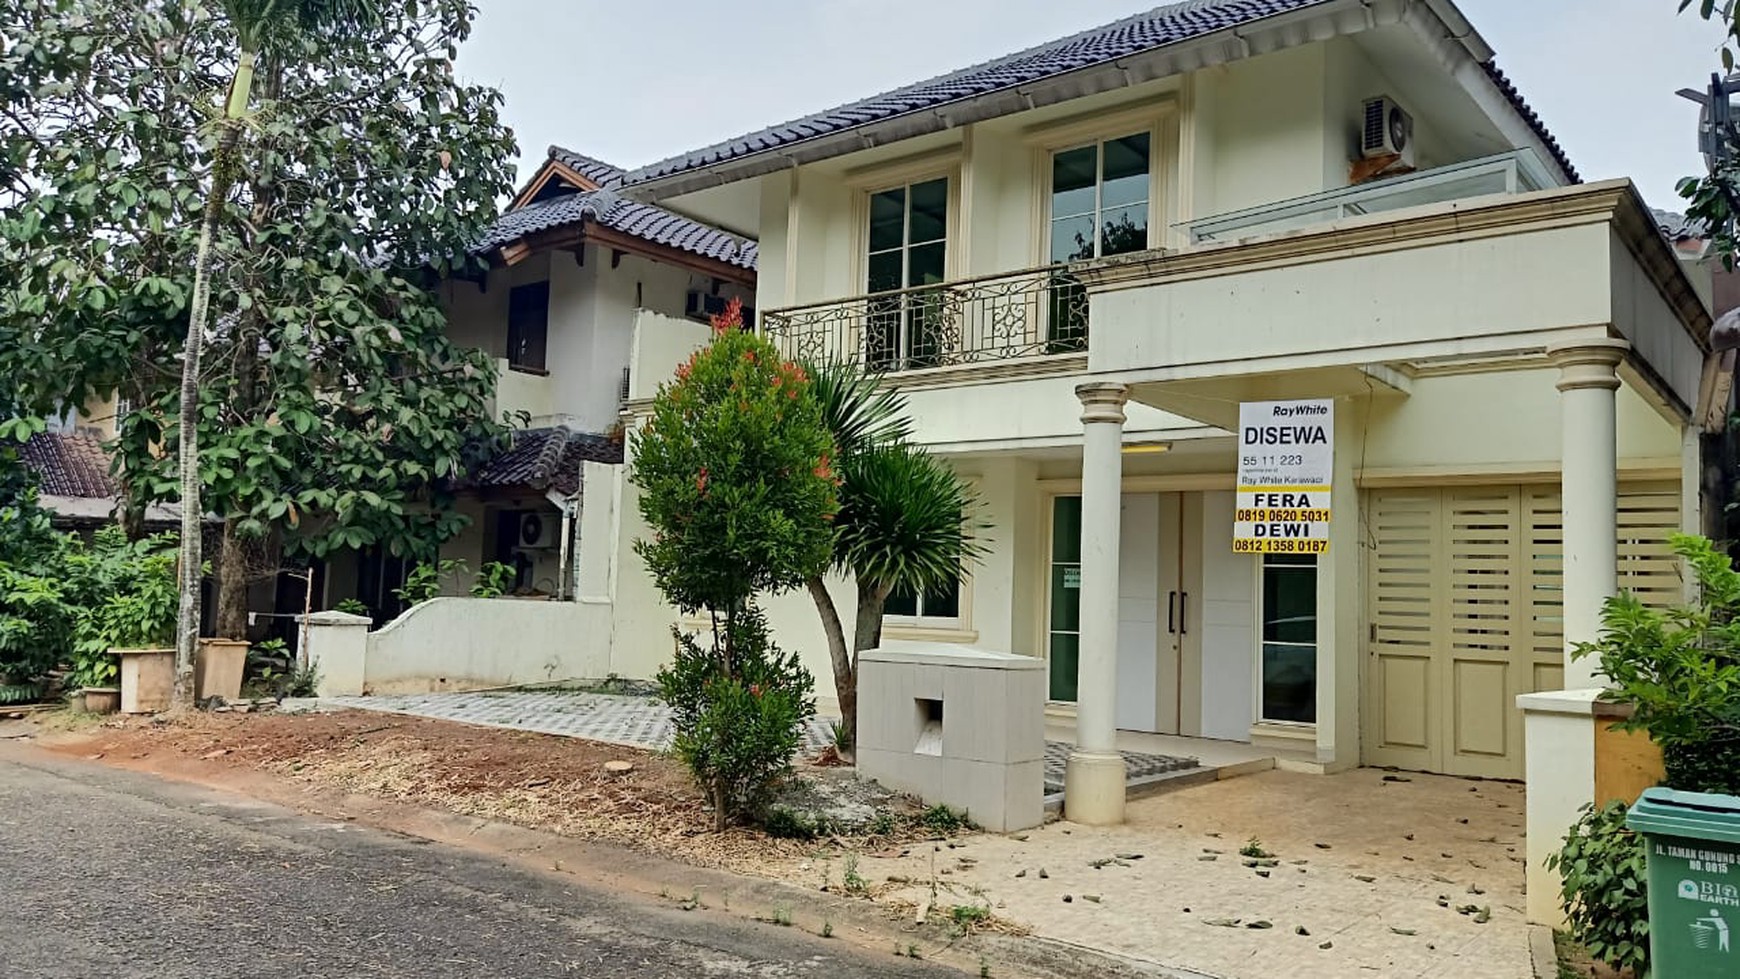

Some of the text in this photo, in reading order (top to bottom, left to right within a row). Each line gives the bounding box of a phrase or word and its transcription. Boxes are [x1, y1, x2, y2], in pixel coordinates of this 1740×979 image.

[1245, 426, 1327, 445] DISEWA
[1243, 455, 1302, 466] 55 11 223
[1242, 476, 1256, 485] Ray
[1259, 476, 1282, 484] White
[1254, 493, 1311, 508] FERA
[1238, 510, 1329, 522] 0819 0620 5031
[1254, 523, 1309, 537] DEWI
[1235, 540, 1327, 551] 0812 1358 0187
[1667, 846, 1697, 859] TAMAN
[1700, 894, 1739, 907] EARTH
